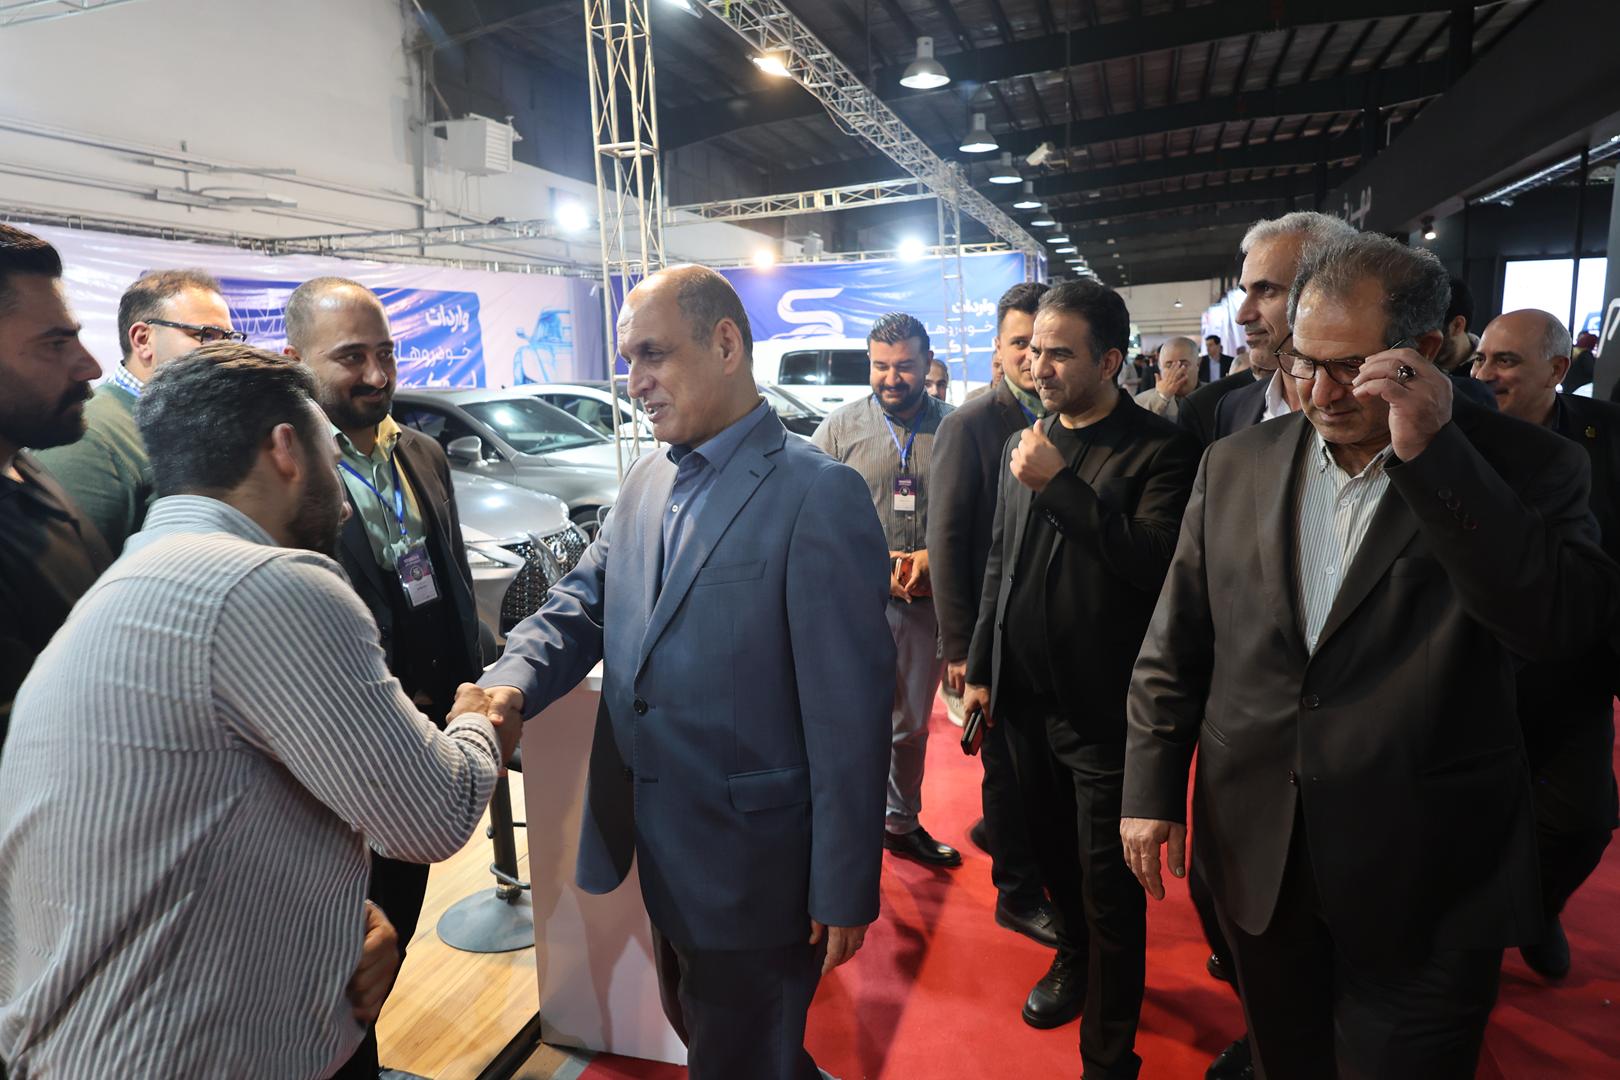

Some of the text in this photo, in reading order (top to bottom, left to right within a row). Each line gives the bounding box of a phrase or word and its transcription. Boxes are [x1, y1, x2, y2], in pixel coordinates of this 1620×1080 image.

[952, 298, 996, 317] واردات
[425, 304, 470, 333] واردات
[925, 320, 995, 337] خودروها
[930, 337, 996, 355] لوک
